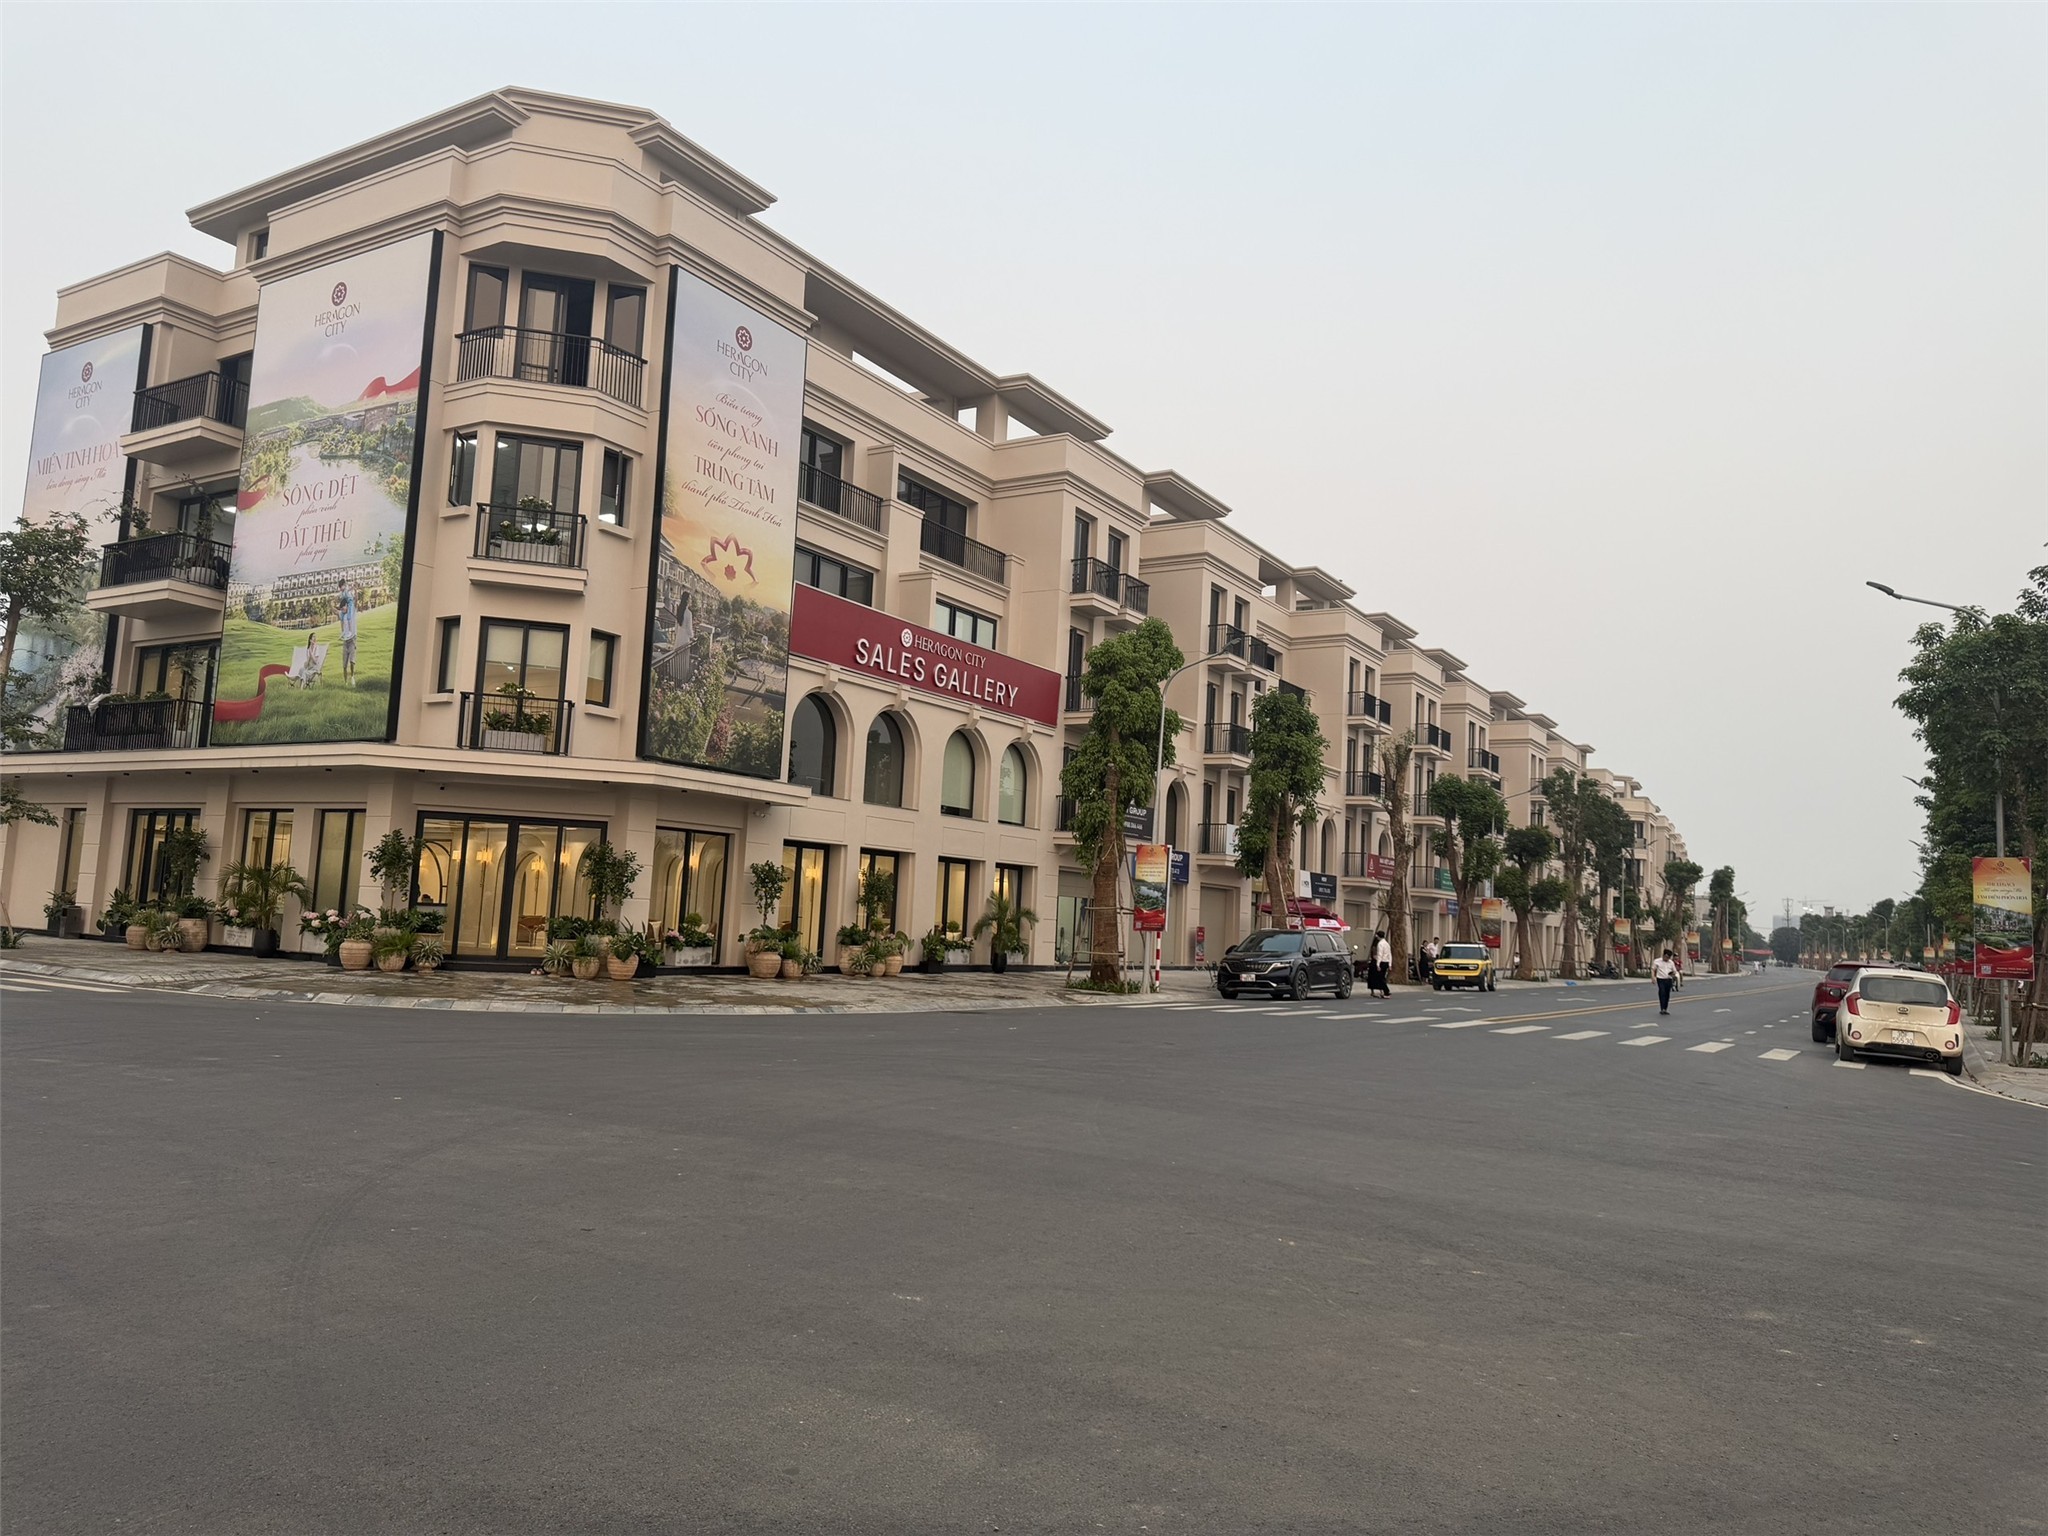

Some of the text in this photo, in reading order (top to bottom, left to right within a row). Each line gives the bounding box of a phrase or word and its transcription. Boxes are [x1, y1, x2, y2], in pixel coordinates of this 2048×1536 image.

[314, 302, 361, 328] HERAGON
[324, 320, 347, 338] CITY
[716, 339, 768, 377] HERAGON
[729, 361, 754, 383] CITY
[68, 380, 103, 400] HERAGON
[75, 395, 92, 409] CITY
[716, 392, 739, 410] Biểu
[695, 404, 778, 458] SỐNG XANH
[65, 446, 92, 470] TINH
[92, 440, 120, 465] HOA
[720, 445, 752, 471] phong
[282, 473, 359, 507] SÔNG DỆT
[693, 454, 775, 504] TRUNG TÂM
[681, 479, 714, 498] thành
[704, 490, 730, 508] phố
[727, 497, 765, 519] Thanh
[279, 518, 353, 550] ĐẤT THÊU
[914, 634, 987, 669] HERAGON CITY
[855, 637, 1019, 708] SALES GALLERY
[1171, 853, 1184, 862] ROUP
